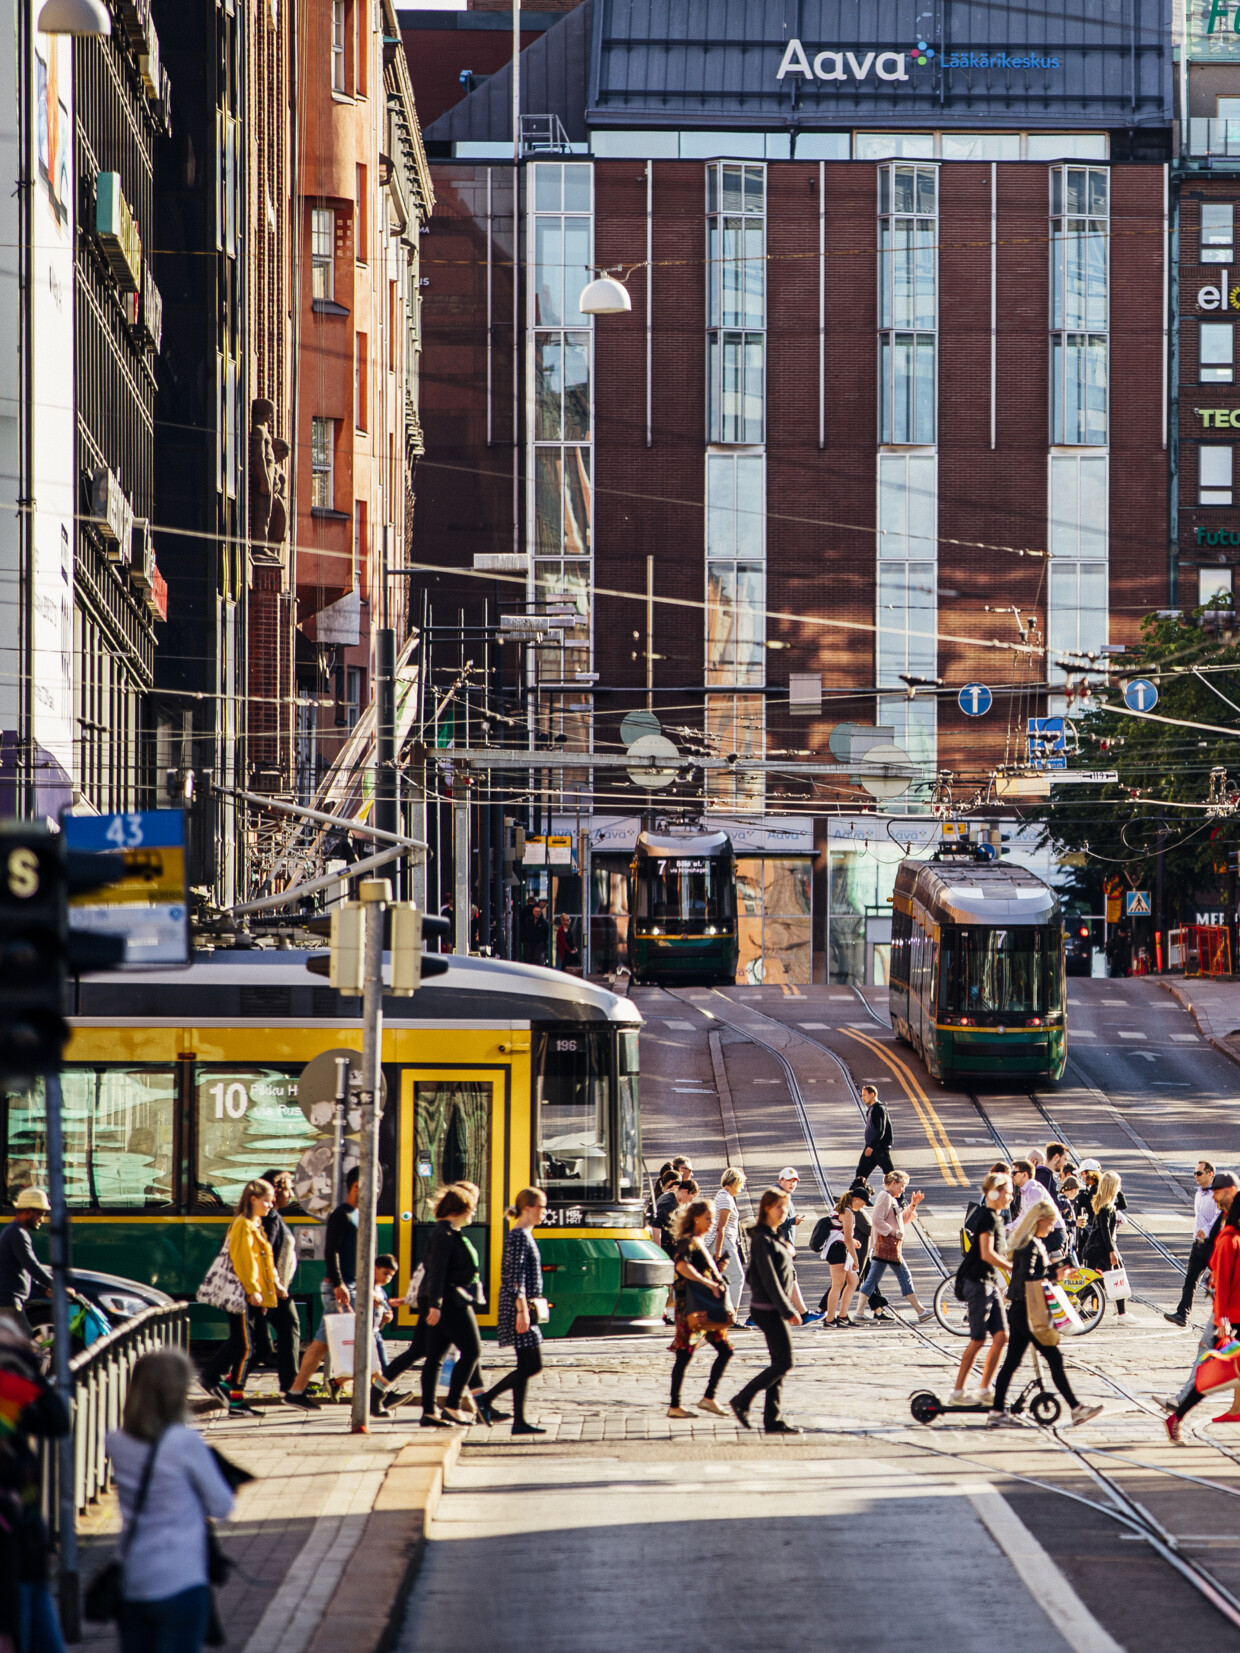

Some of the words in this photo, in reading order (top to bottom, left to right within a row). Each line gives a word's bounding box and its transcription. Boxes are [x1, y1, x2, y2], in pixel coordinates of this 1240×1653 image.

[776, 39, 909, 81] Aava
[940, 52, 1060, 69] Lääkärikeskus
[105, 815, 144, 847] 43
[8, 847, 40, 898] S
[657, 860, 667, 875] 7
[995, 930, 1007, 948] 7
[556, 1040, 577, 1051] 196
[209, 1082, 249, 1119] 10
[250, 1084, 285, 1096] Pikku
[254, 1106, 273, 1116] via
[279, 1104, 303, 1116] Rus
